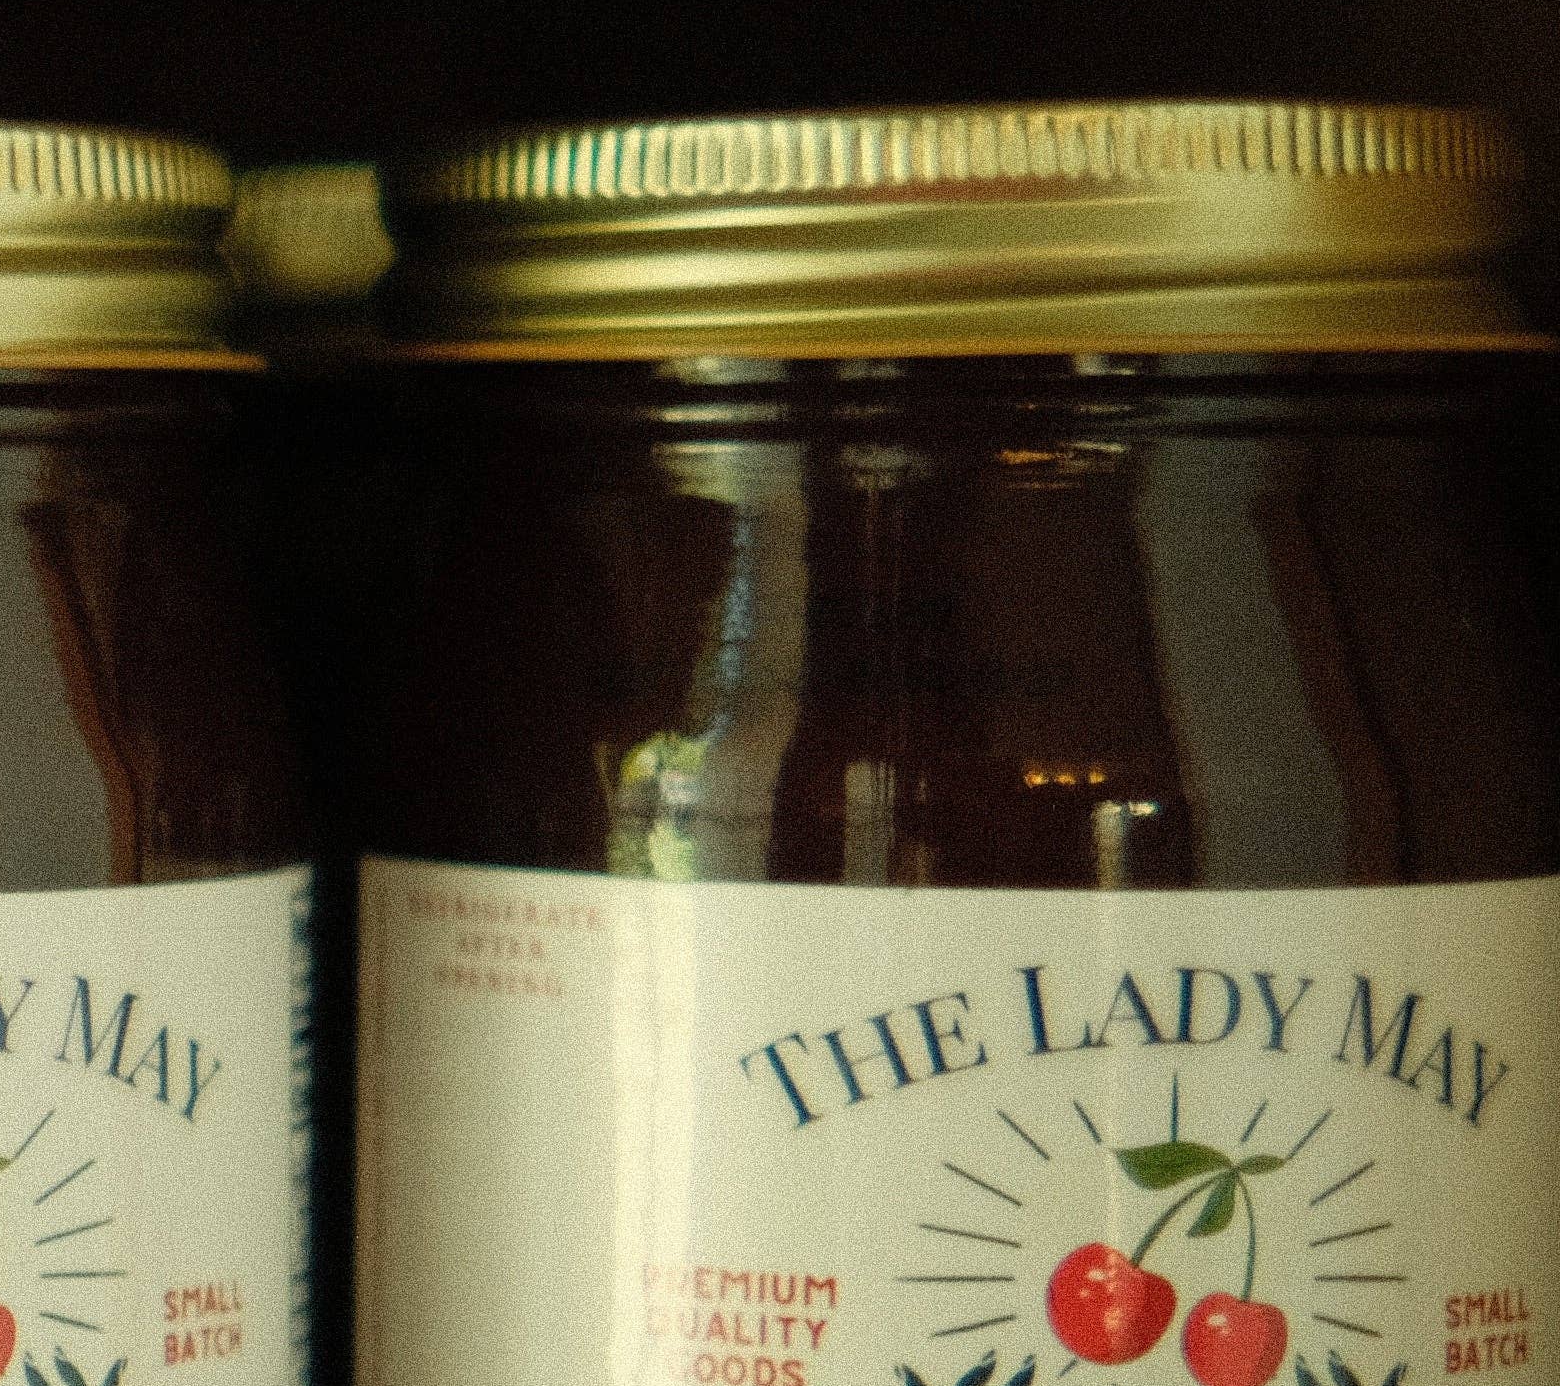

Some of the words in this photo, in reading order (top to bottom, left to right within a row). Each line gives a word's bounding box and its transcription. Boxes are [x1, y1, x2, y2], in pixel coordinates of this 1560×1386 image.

[55, 977, 223, 1121] MAY
[740, 993, 991, 1129] THE
[1016, 967, 1314, 1055] LADY
[1333, 975, 1510, 1127] MAY
[161, 1283, 245, 1323] SMALL
[1444, 1292, 1532, 1331] SMALL
[162, 1322, 245, 1366] BATCH
[1445, 1335, 1532, 1375] BATCH
